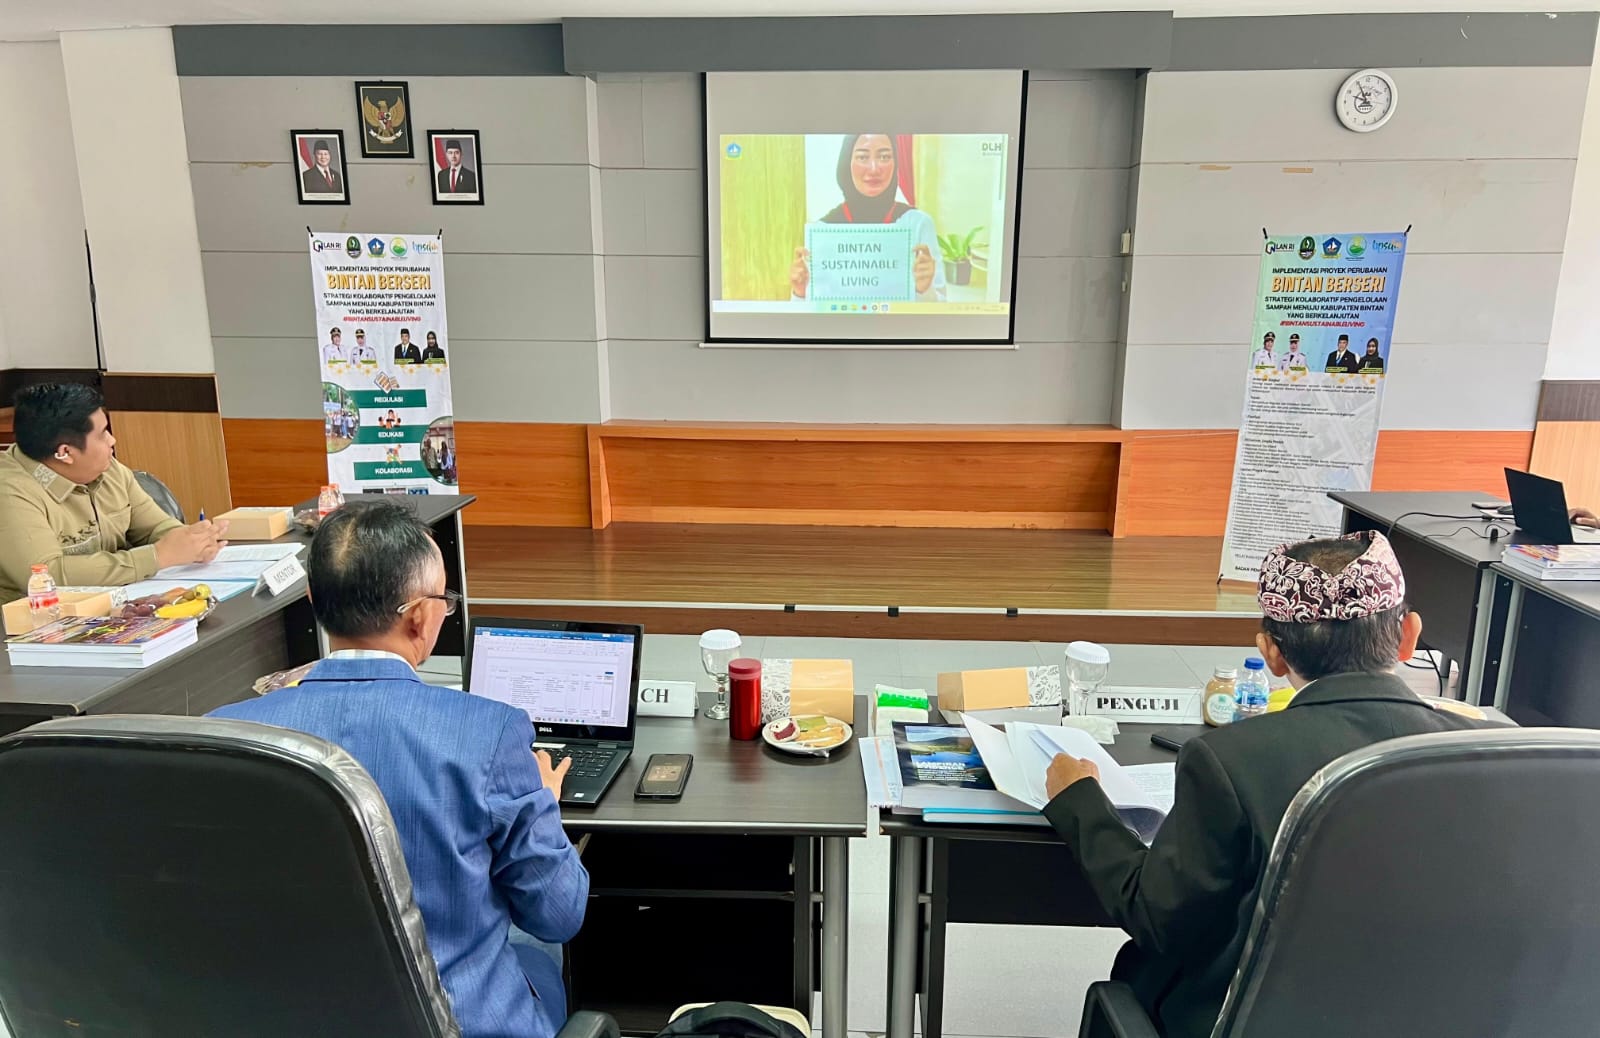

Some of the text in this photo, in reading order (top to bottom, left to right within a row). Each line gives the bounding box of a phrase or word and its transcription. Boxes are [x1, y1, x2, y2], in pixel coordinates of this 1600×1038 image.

[982, 143, 1002, 151] DLH
[837, 243, 882, 254] BINTAN
[821, 259, 898, 270] SUSTAINABLE
[327, 274, 432, 290] BINTAN BERSERI
[841, 276, 879, 287] LIVING
[1271, 276, 1386, 293] BINTAN BERSERI
[374, 396, 404, 404] REGULASI
[374, 467, 413, 475] KOLABORASI
[273, 563, 298, 583] MENTOR
[640, 687, 670, 703] CH
[1096, 696, 1180, 711] PENGUJI
